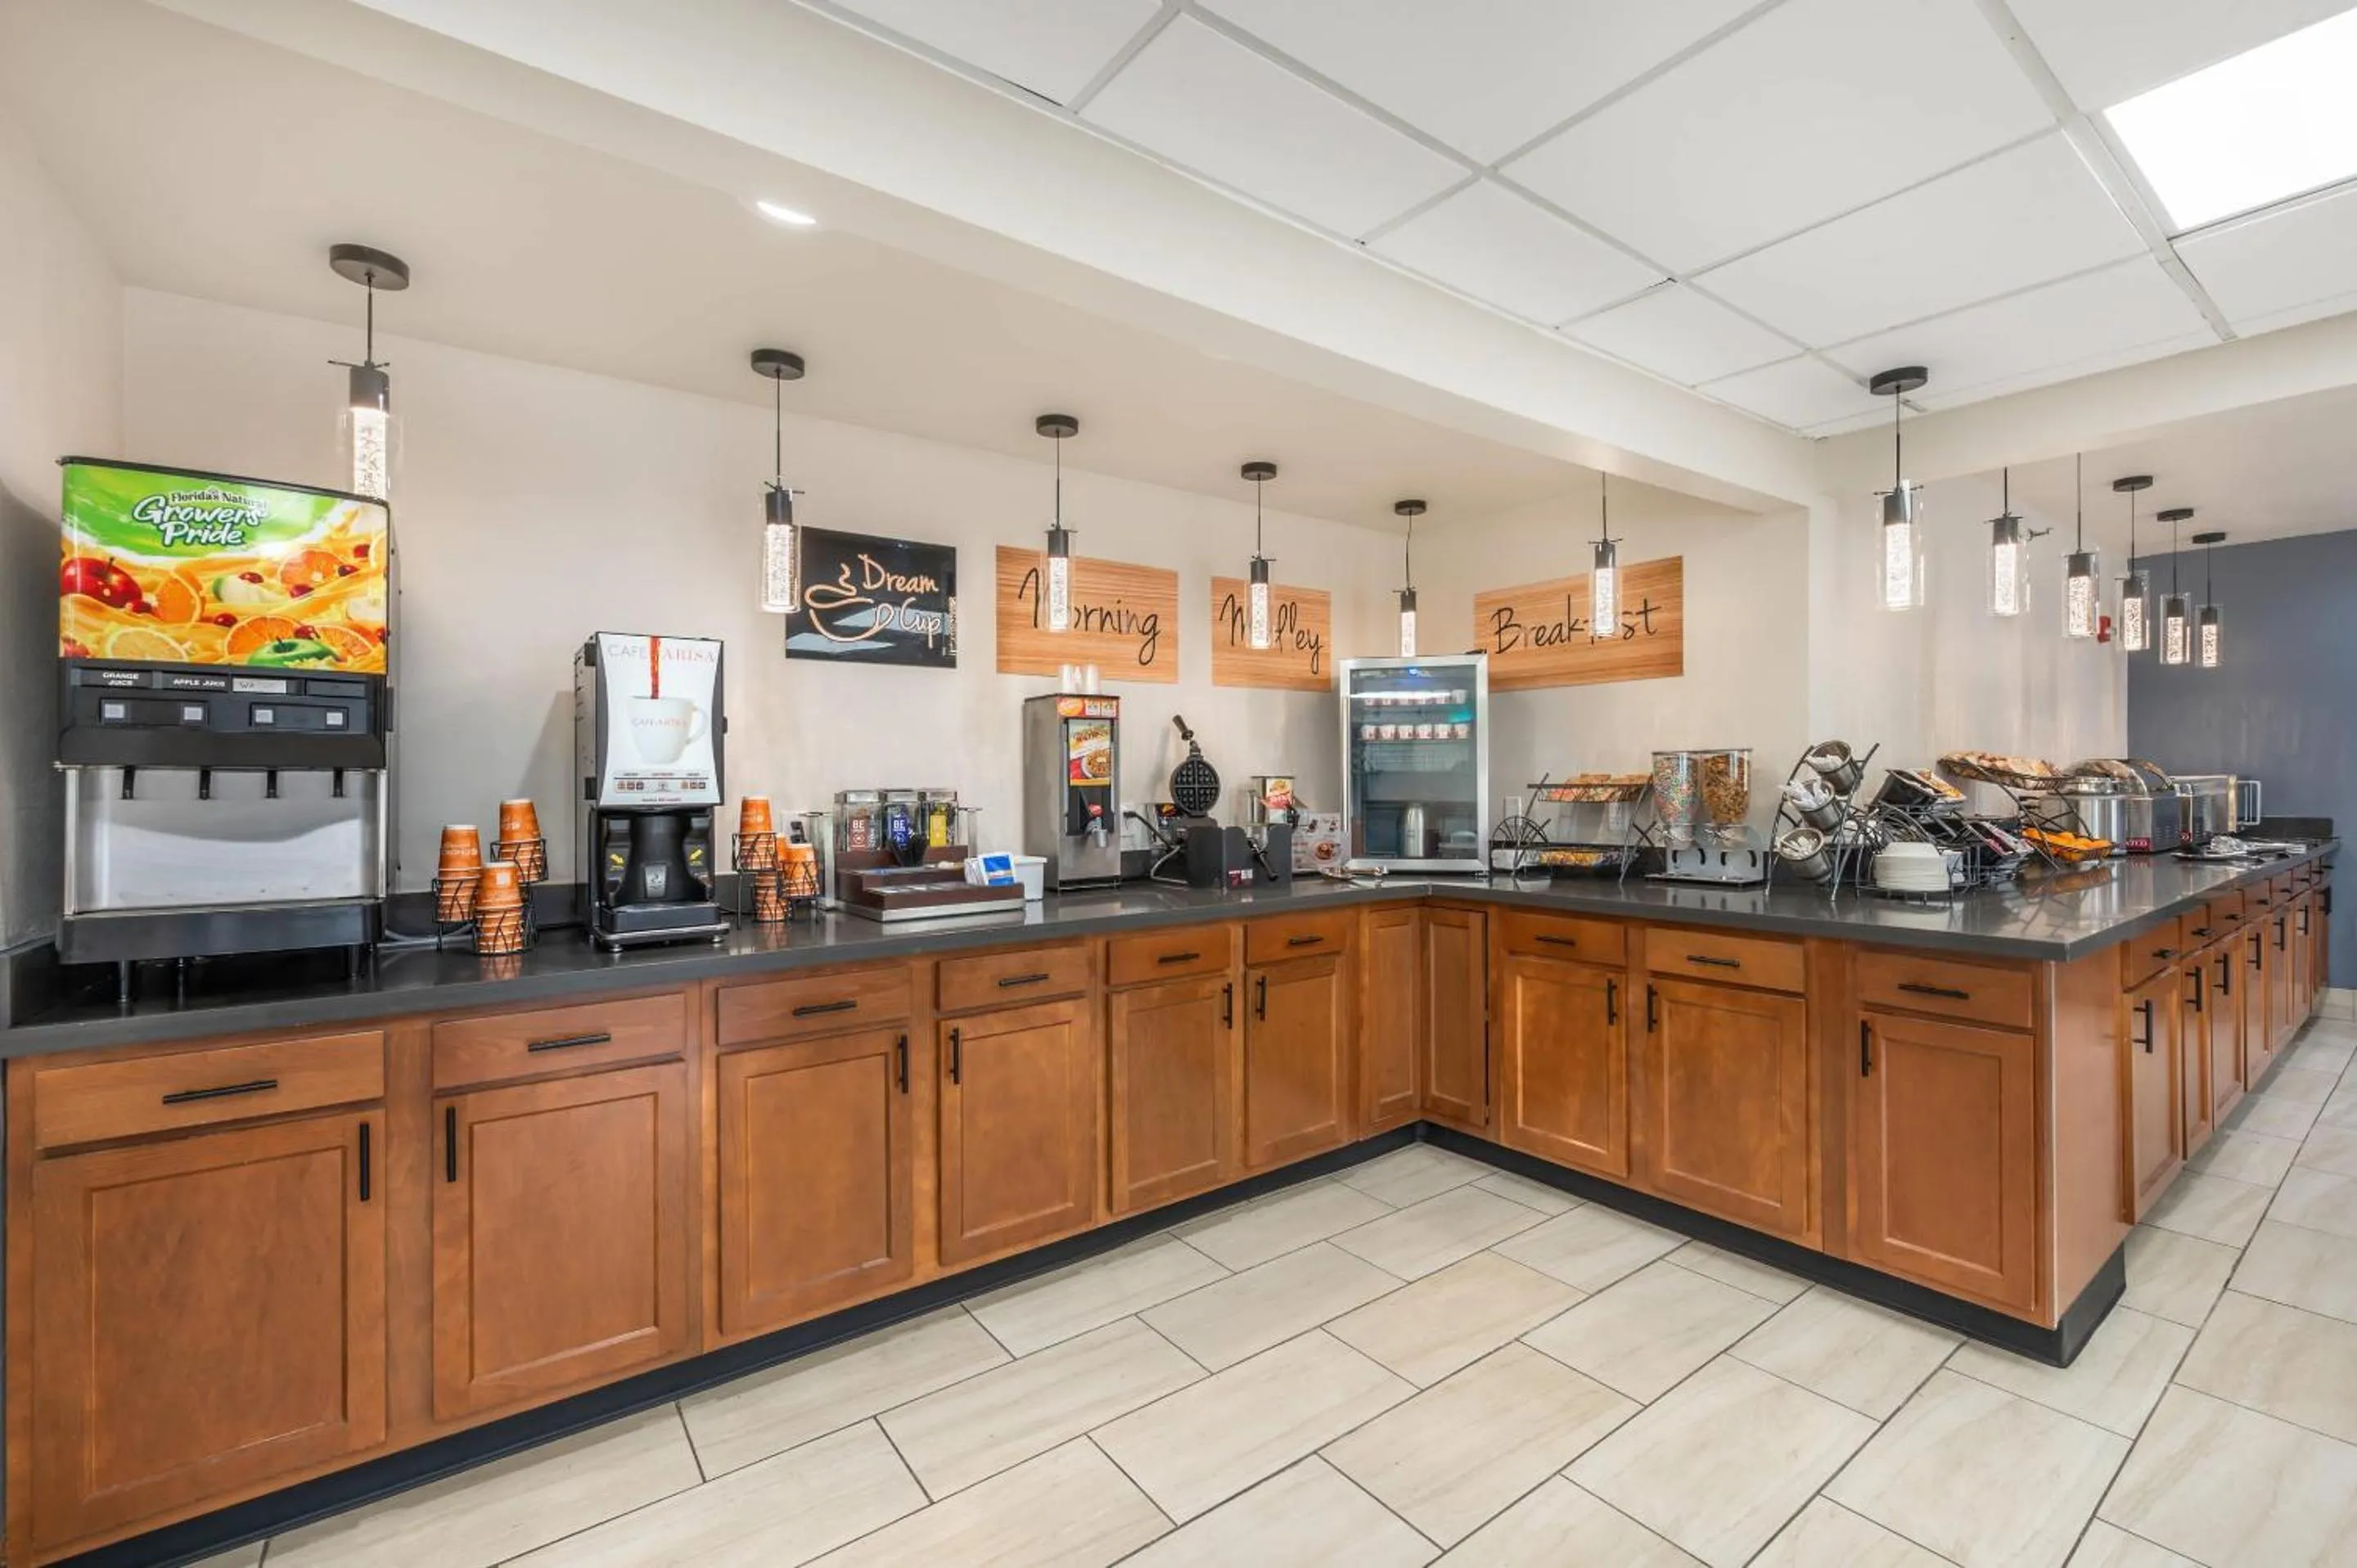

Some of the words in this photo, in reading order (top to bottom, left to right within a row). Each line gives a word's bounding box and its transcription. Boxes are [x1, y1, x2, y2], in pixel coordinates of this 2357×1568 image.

[159, 520, 245, 546] Pride
[858, 553, 940, 593] Dream
[900, 597, 941, 650] Cup
[172, 678, 201, 687] APPLE
